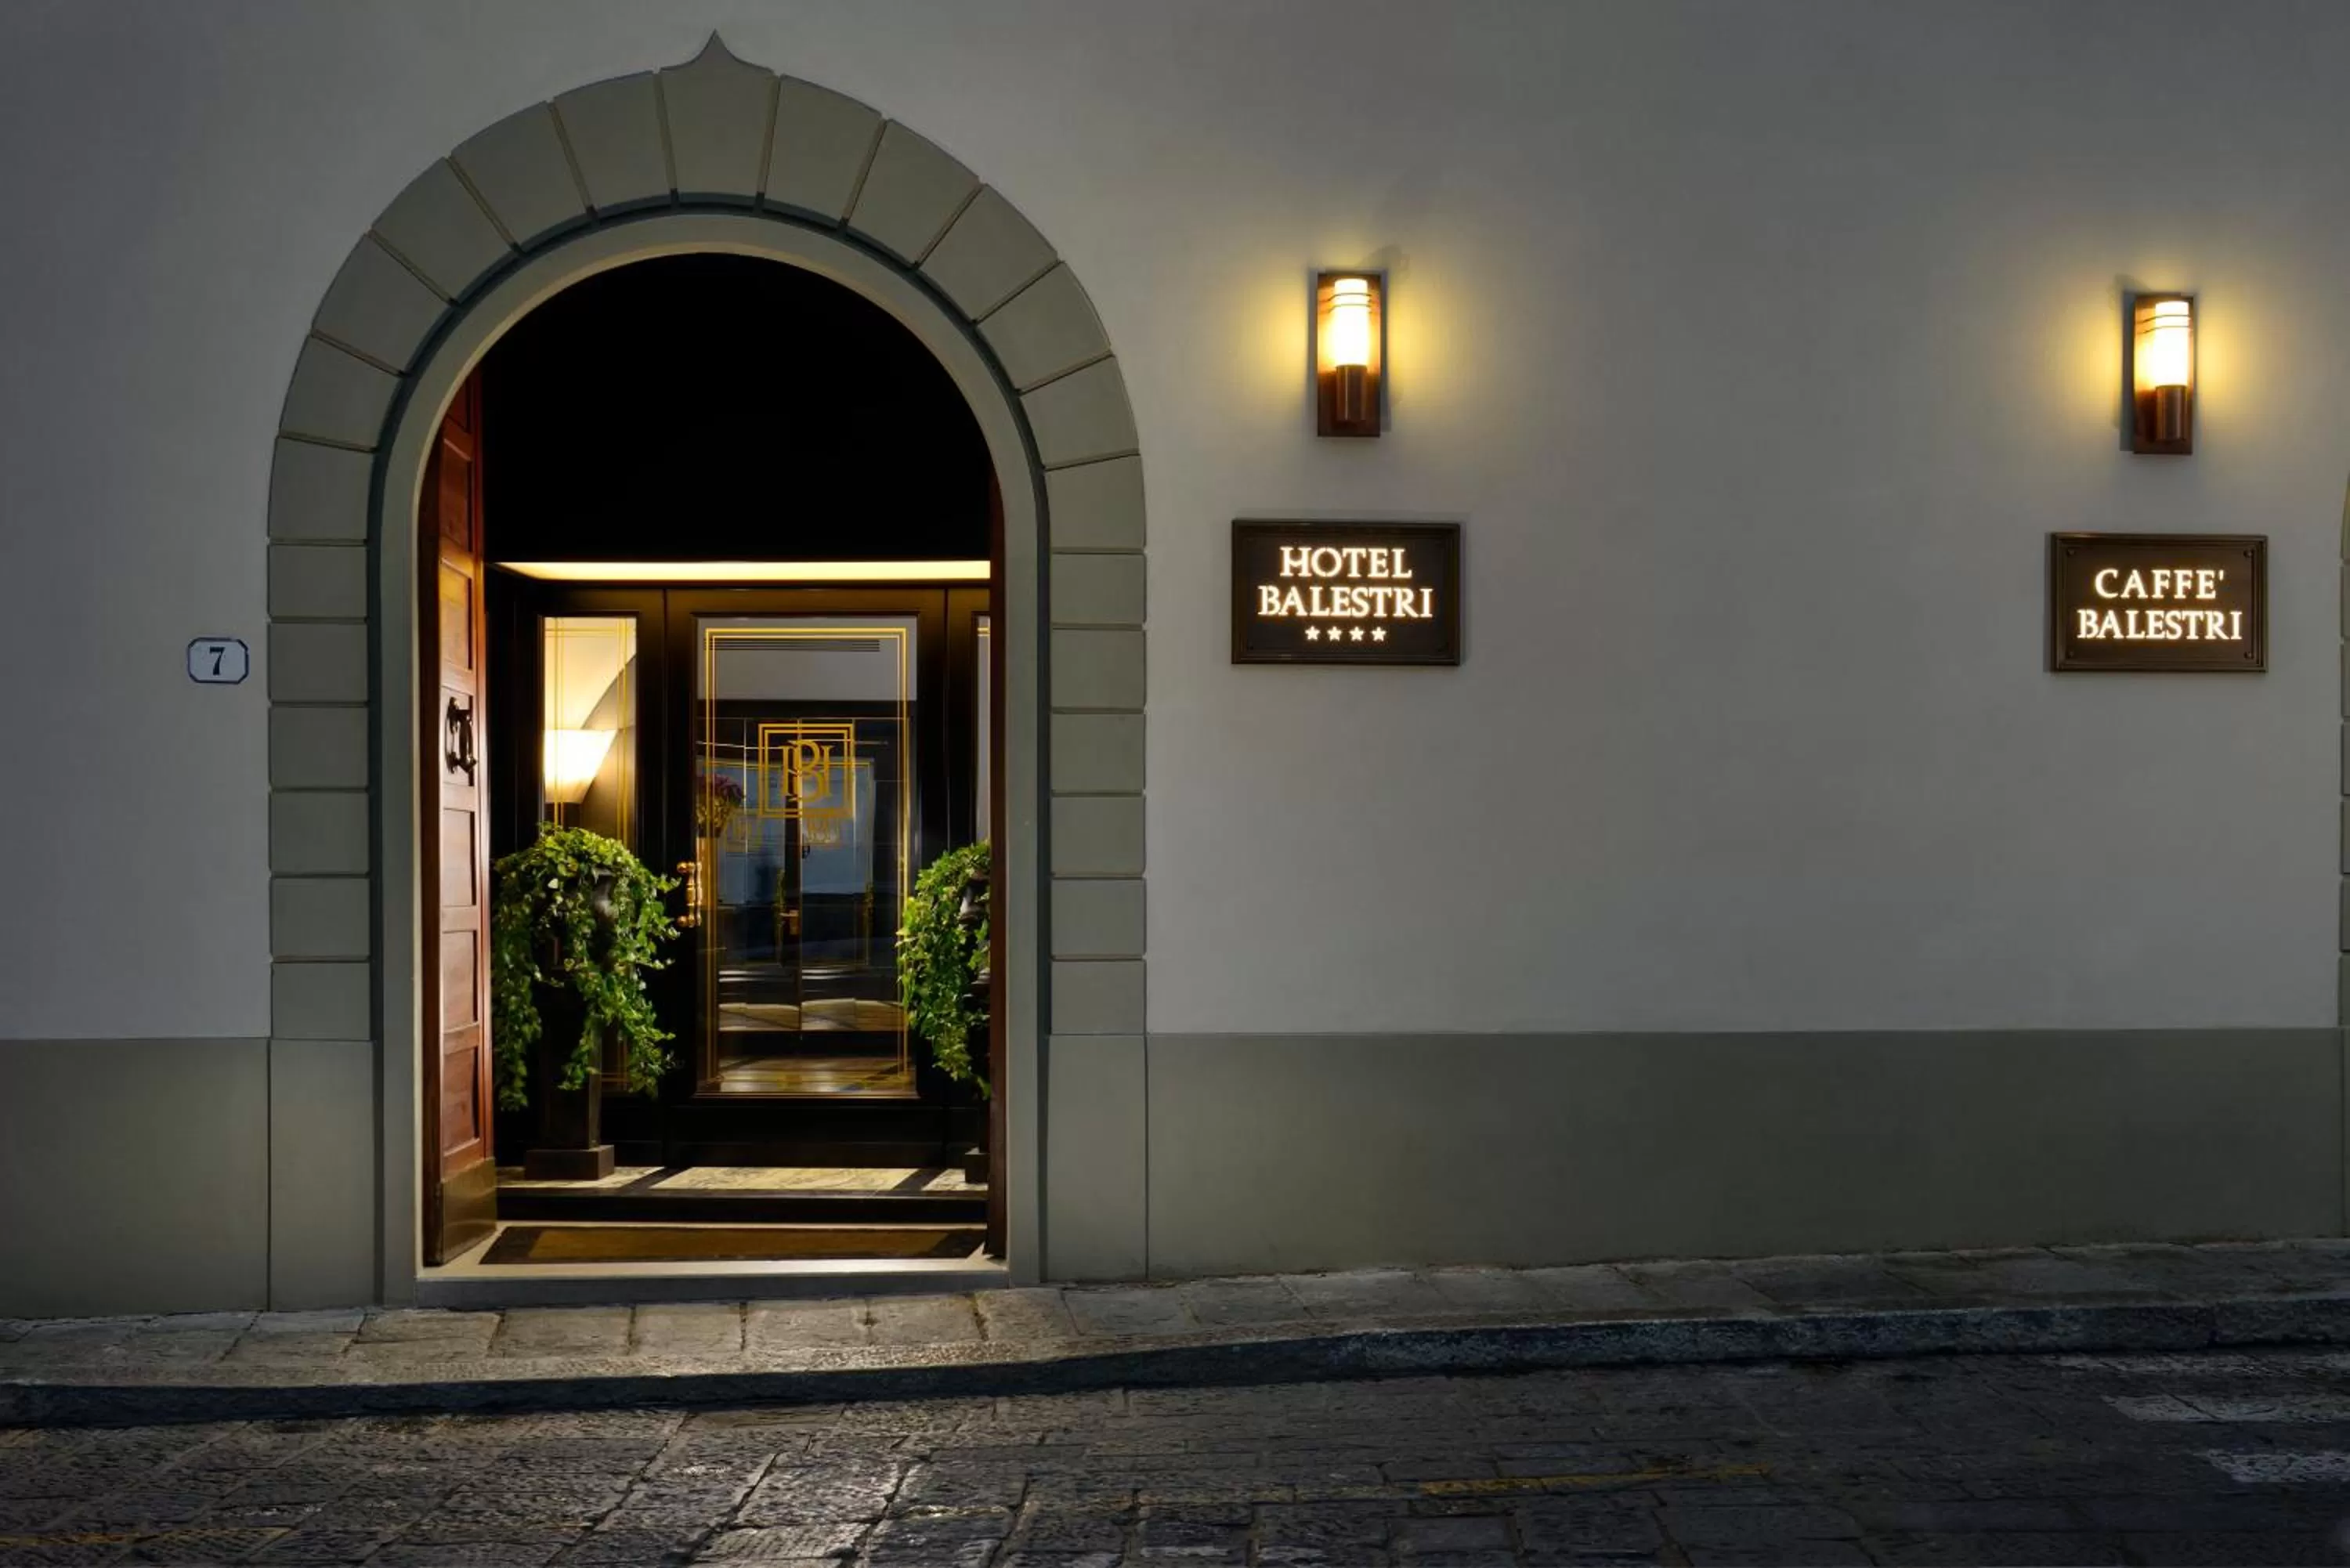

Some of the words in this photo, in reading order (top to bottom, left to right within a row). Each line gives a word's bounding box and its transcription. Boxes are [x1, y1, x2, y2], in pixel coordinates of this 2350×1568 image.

[1278, 546, 1412, 579] HOTEL
[2094, 568, 2225, 599] CAFFE'
[1257, 585, 1434, 618] BALESTRI
[2077, 608, 2243, 640] BALESTRI
[209, 646, 226, 676] 7
